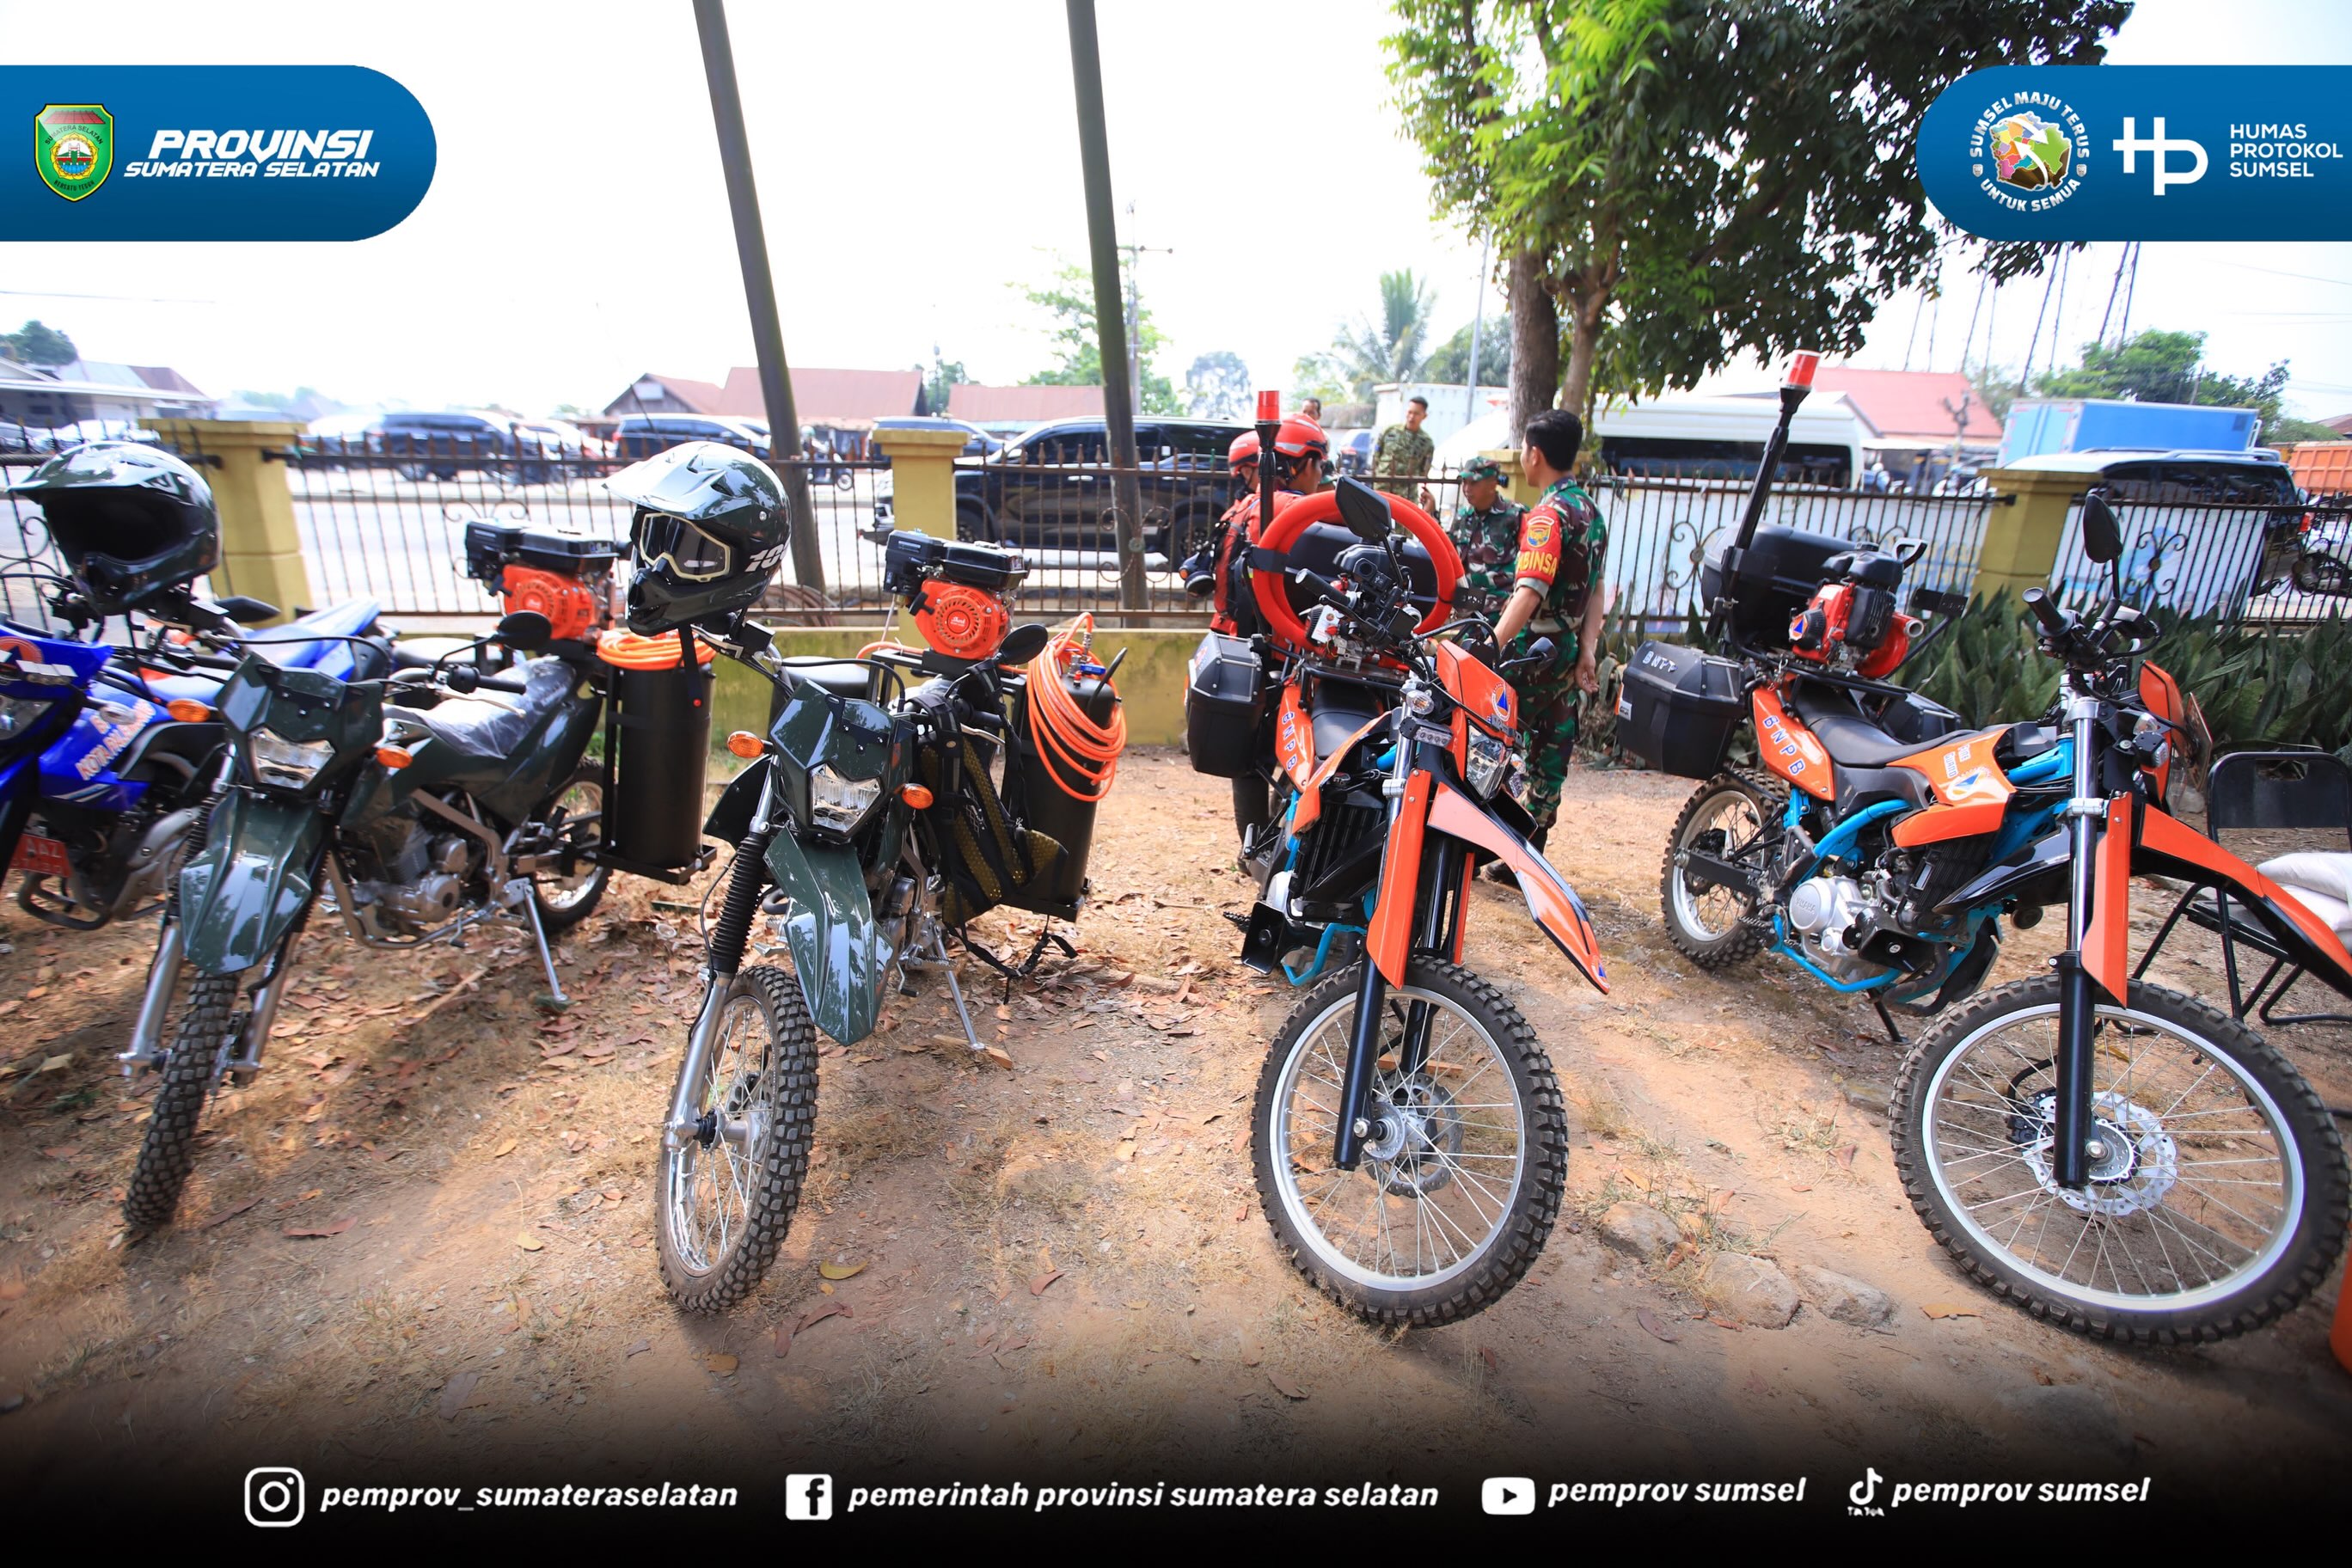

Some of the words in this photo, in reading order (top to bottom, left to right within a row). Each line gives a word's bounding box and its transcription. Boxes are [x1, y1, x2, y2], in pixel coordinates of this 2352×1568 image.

[744, 544, 787, 573] 10
[1282, 712, 1297, 770] BNPB
[1764, 715, 1805, 775] BNPB
